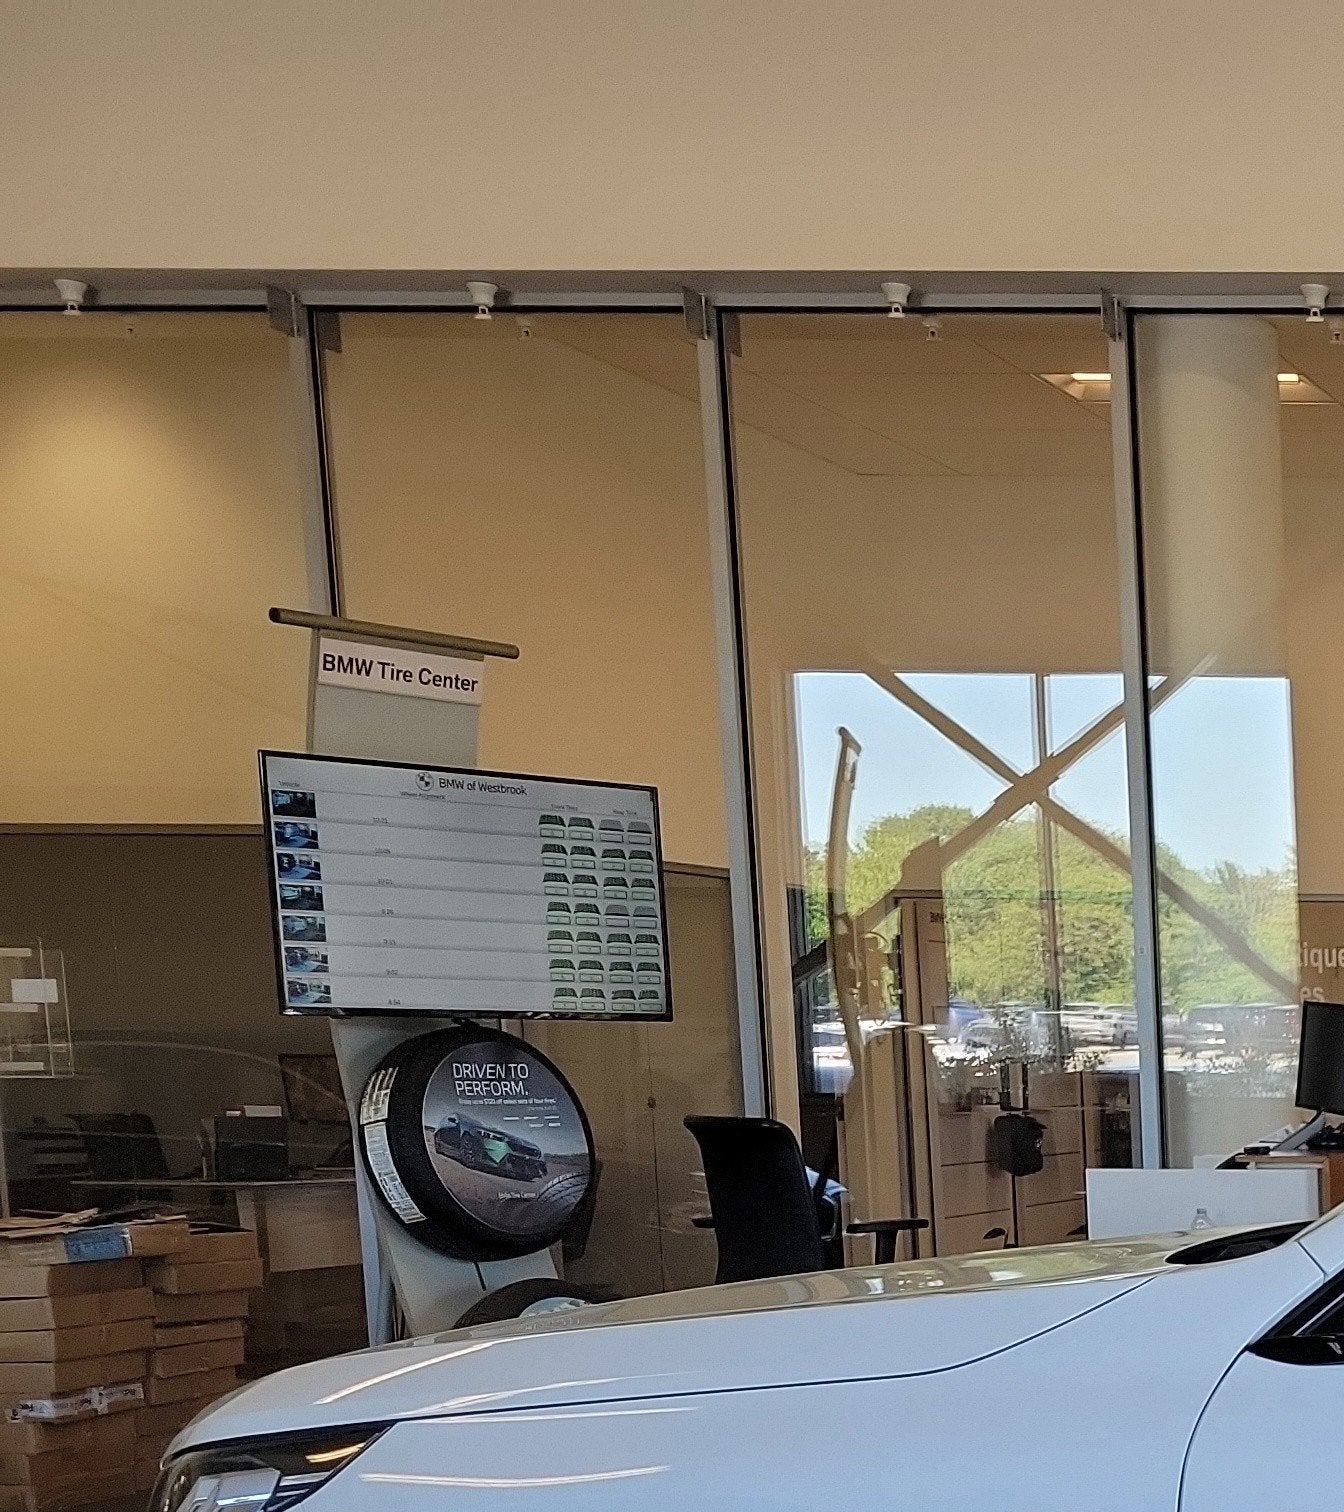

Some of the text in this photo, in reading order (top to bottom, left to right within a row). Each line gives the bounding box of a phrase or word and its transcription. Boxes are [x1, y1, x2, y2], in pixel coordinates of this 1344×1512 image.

[322, 652, 479, 692] BMW Tire Center
[438, 777, 528, 796] BMW of Westbrook
[452, 1063, 529, 1079] DRIVEN TO
[455, 1081, 529, 1096] PERFORM.
